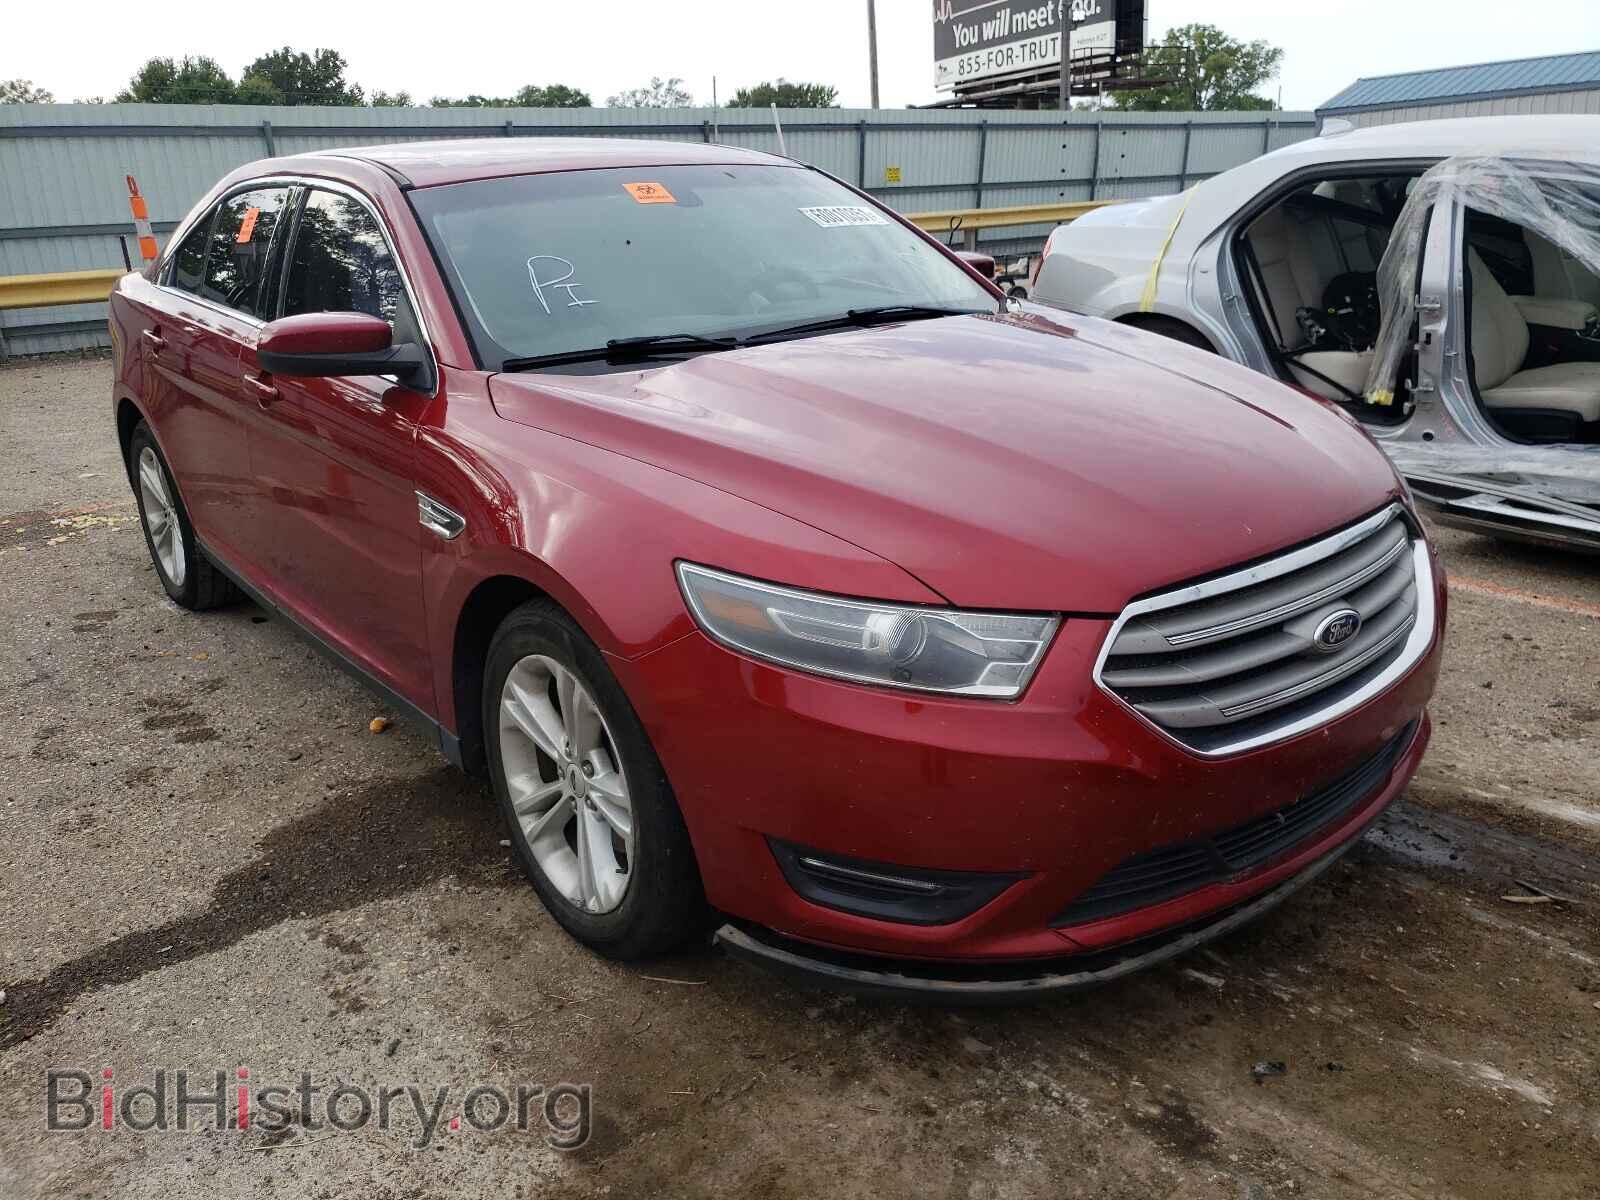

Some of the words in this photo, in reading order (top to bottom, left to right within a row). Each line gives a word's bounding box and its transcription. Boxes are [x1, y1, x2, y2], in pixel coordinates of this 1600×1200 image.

[953, 24, 978, 49] You
[982, 8, 1010, 41] will
[1012, 1, 1055, 34] meet
[958, 37, 1060, 77] 855-FOR-TRUT
[1329, 618, 1353, 643] Ford
